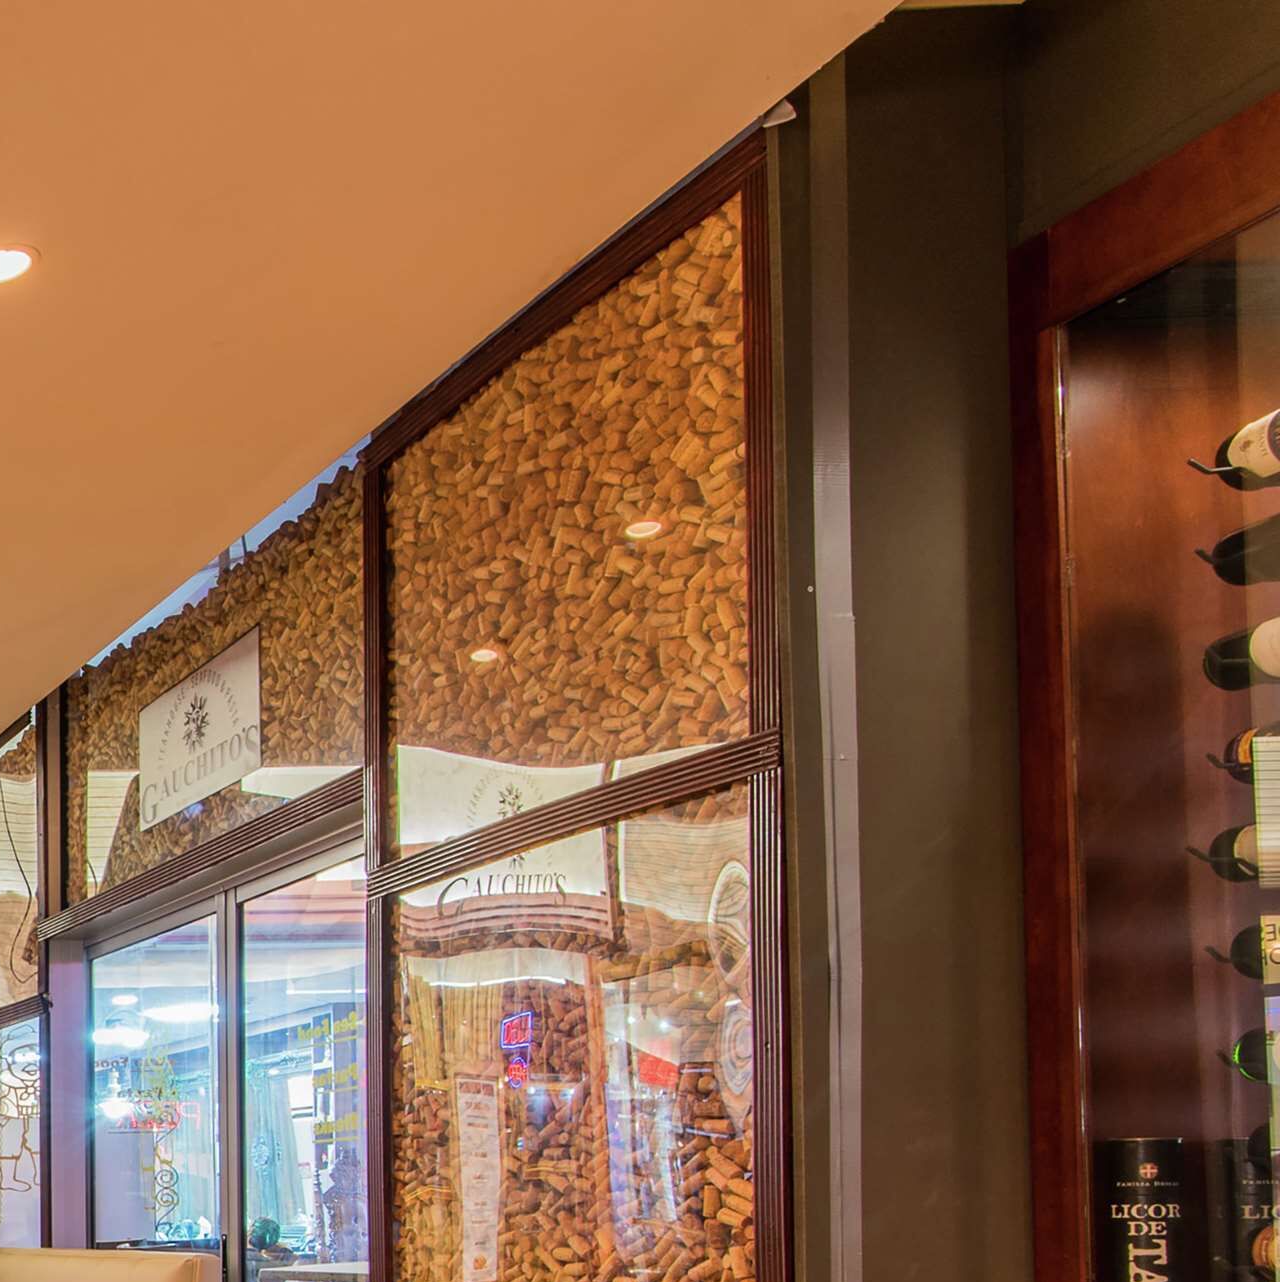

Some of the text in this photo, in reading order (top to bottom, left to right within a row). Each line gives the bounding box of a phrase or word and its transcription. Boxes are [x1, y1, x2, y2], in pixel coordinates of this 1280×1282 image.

[142, 725, 259, 824] GAUCHITO'S
[437, 873, 566, 918] GAUCHITO'S
[1111, 1203, 1182, 1220] LICOR
[1128, 1221, 1168, 1237] DE
